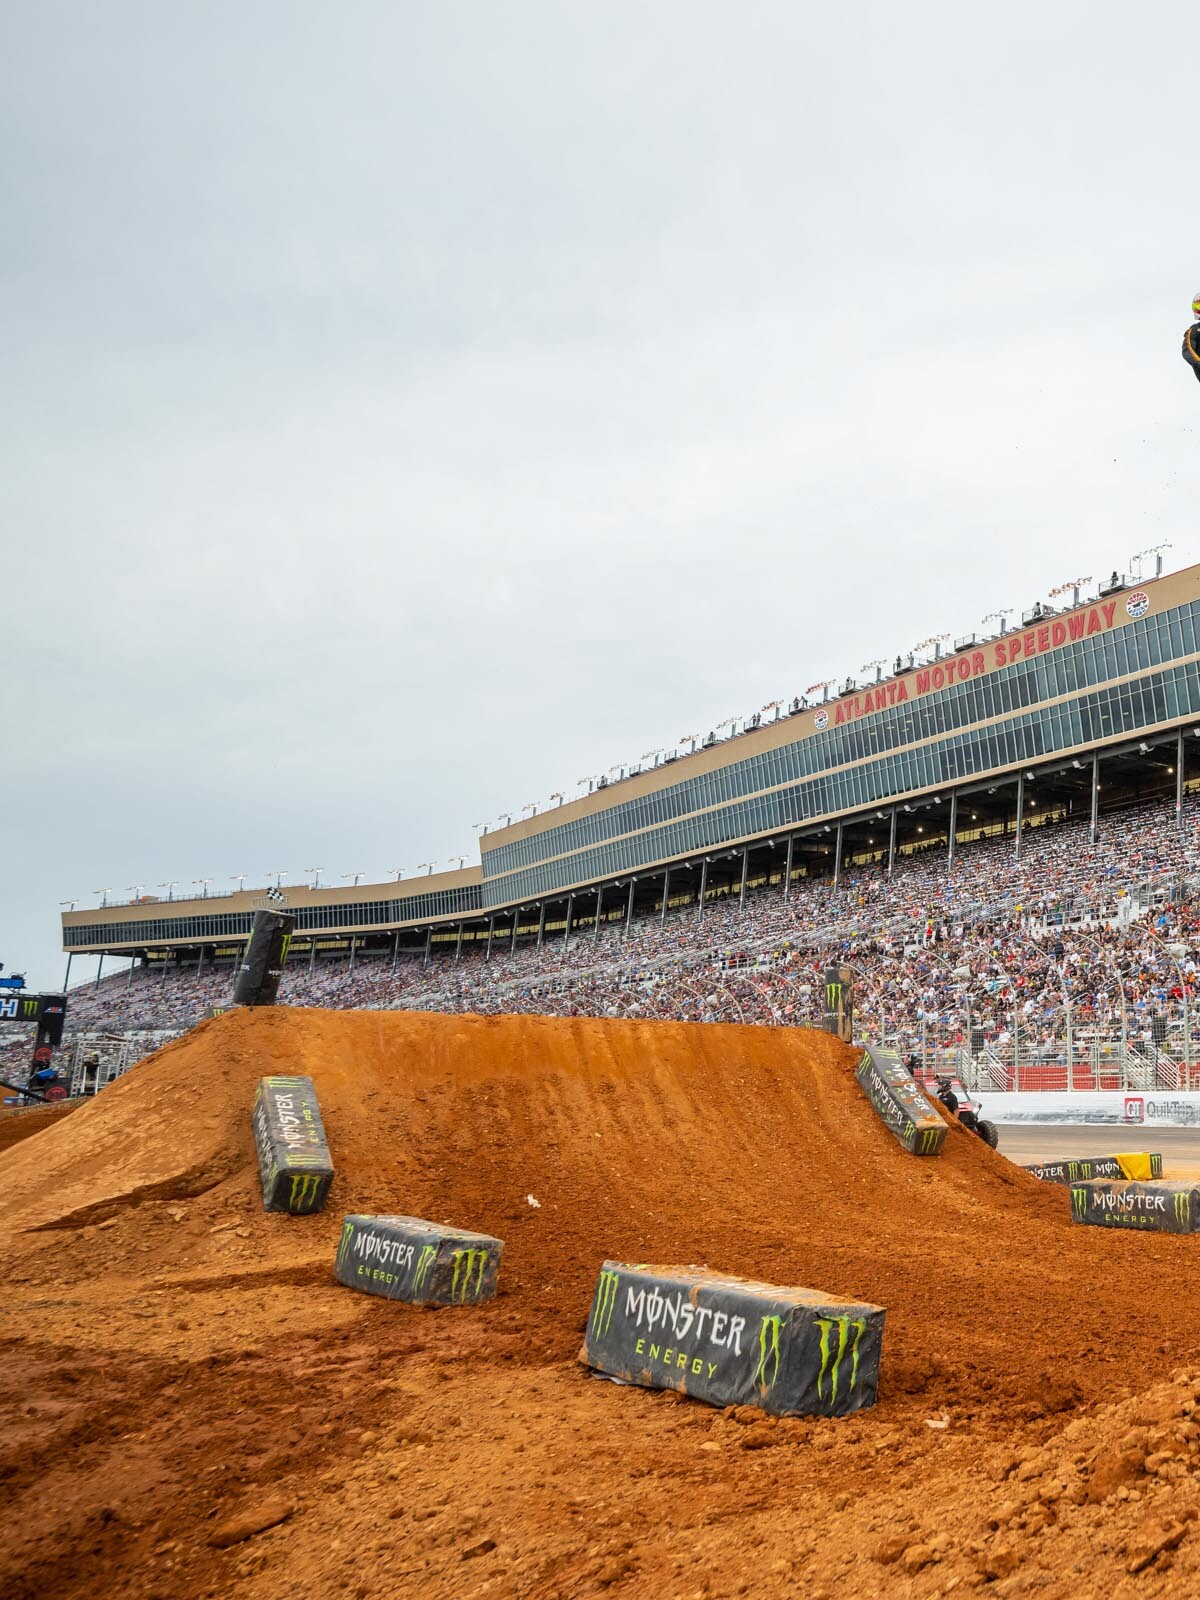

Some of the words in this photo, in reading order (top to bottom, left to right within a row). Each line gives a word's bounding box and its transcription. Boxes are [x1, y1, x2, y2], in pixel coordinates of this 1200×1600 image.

[834, 679, 908, 725] ATLANTA
[916, 652, 986, 695] MOTOR
[994, 602, 1118, 667] SPEEDWAY
[1092, 1190, 1166, 1212] MONSTER
[1105, 1214, 1156, 1224] ENERGY
[353, 1230, 415, 1270] MONSTER
[357, 1264, 400, 1284] ENERGY
[625, 1286, 746, 1357] MONSTER
[635, 1338, 719, 1379] ENERGY
